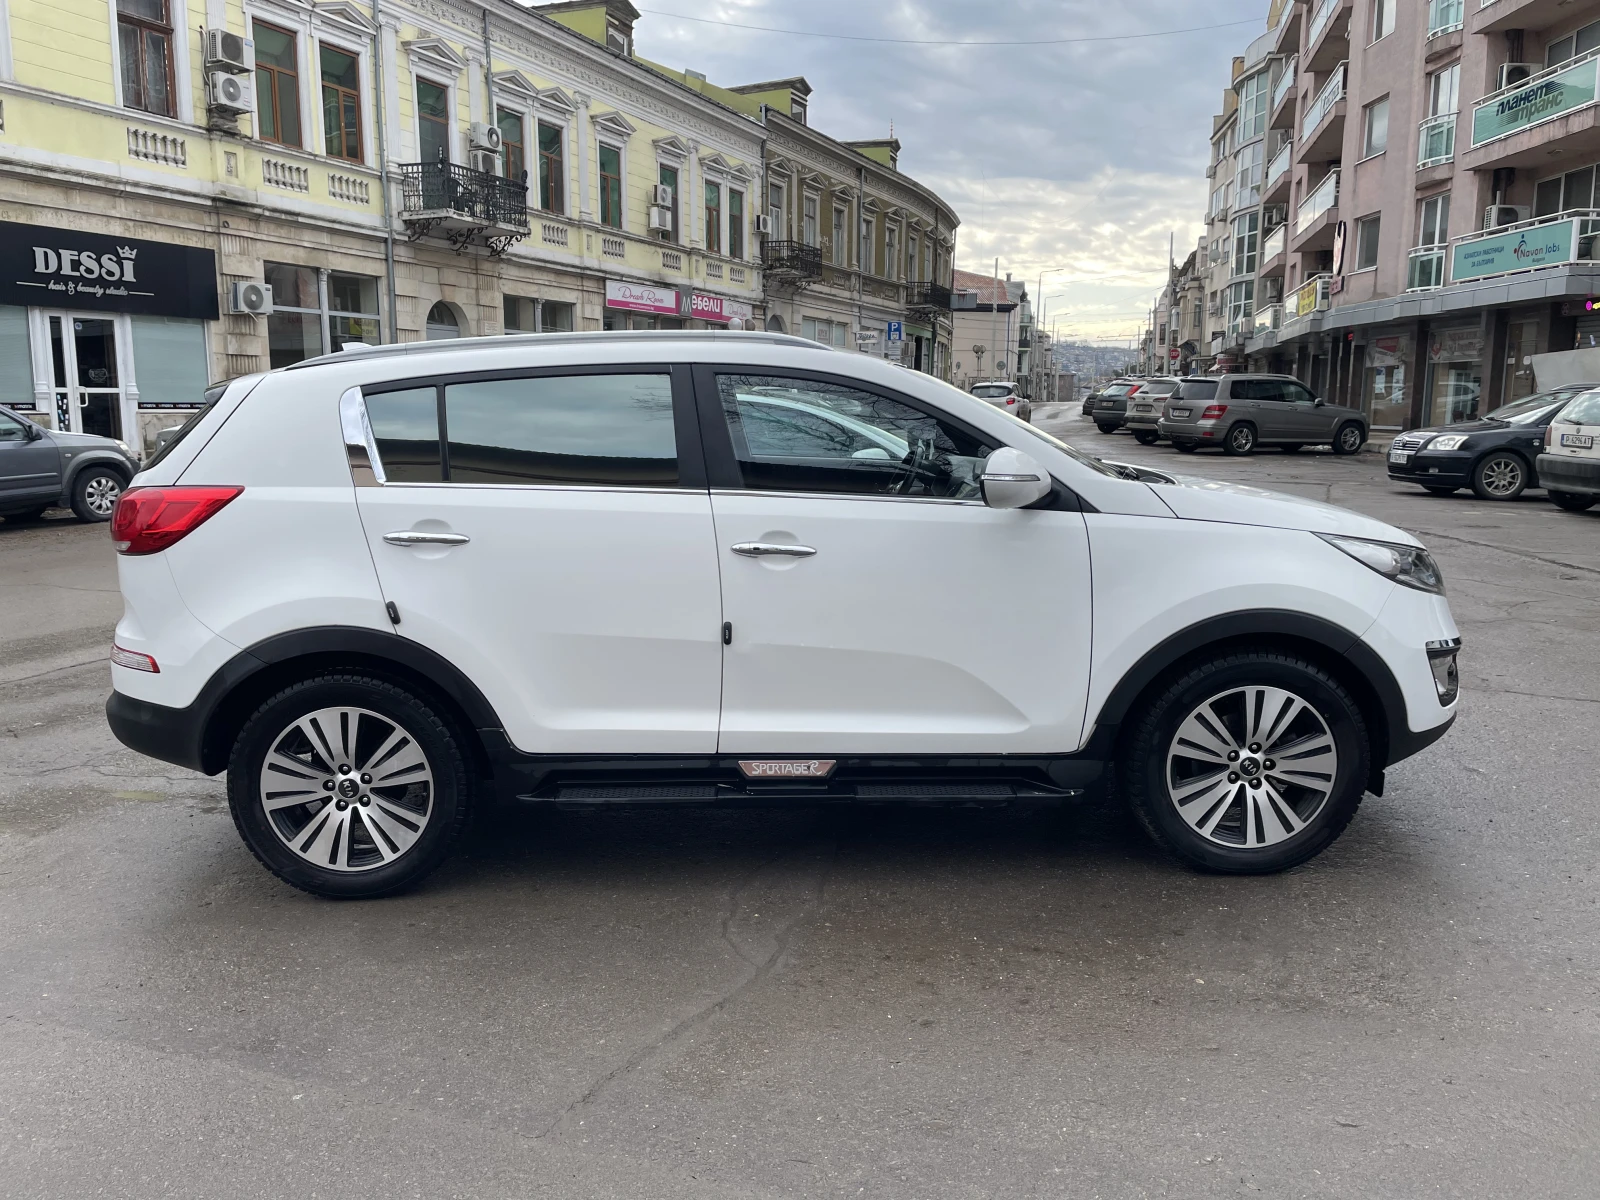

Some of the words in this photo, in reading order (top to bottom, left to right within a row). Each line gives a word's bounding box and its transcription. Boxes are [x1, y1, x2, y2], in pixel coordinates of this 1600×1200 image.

[1520, 247, 1544, 259] Navan
[1545, 242, 1560, 255] Jobs
[618, 286, 644, 301] Dream
[641, 289, 664, 305] Room
[891, 322, 898, 332] P
[1243, 759, 1257, 774] KIA
[343, 781, 353, 797] KIA
